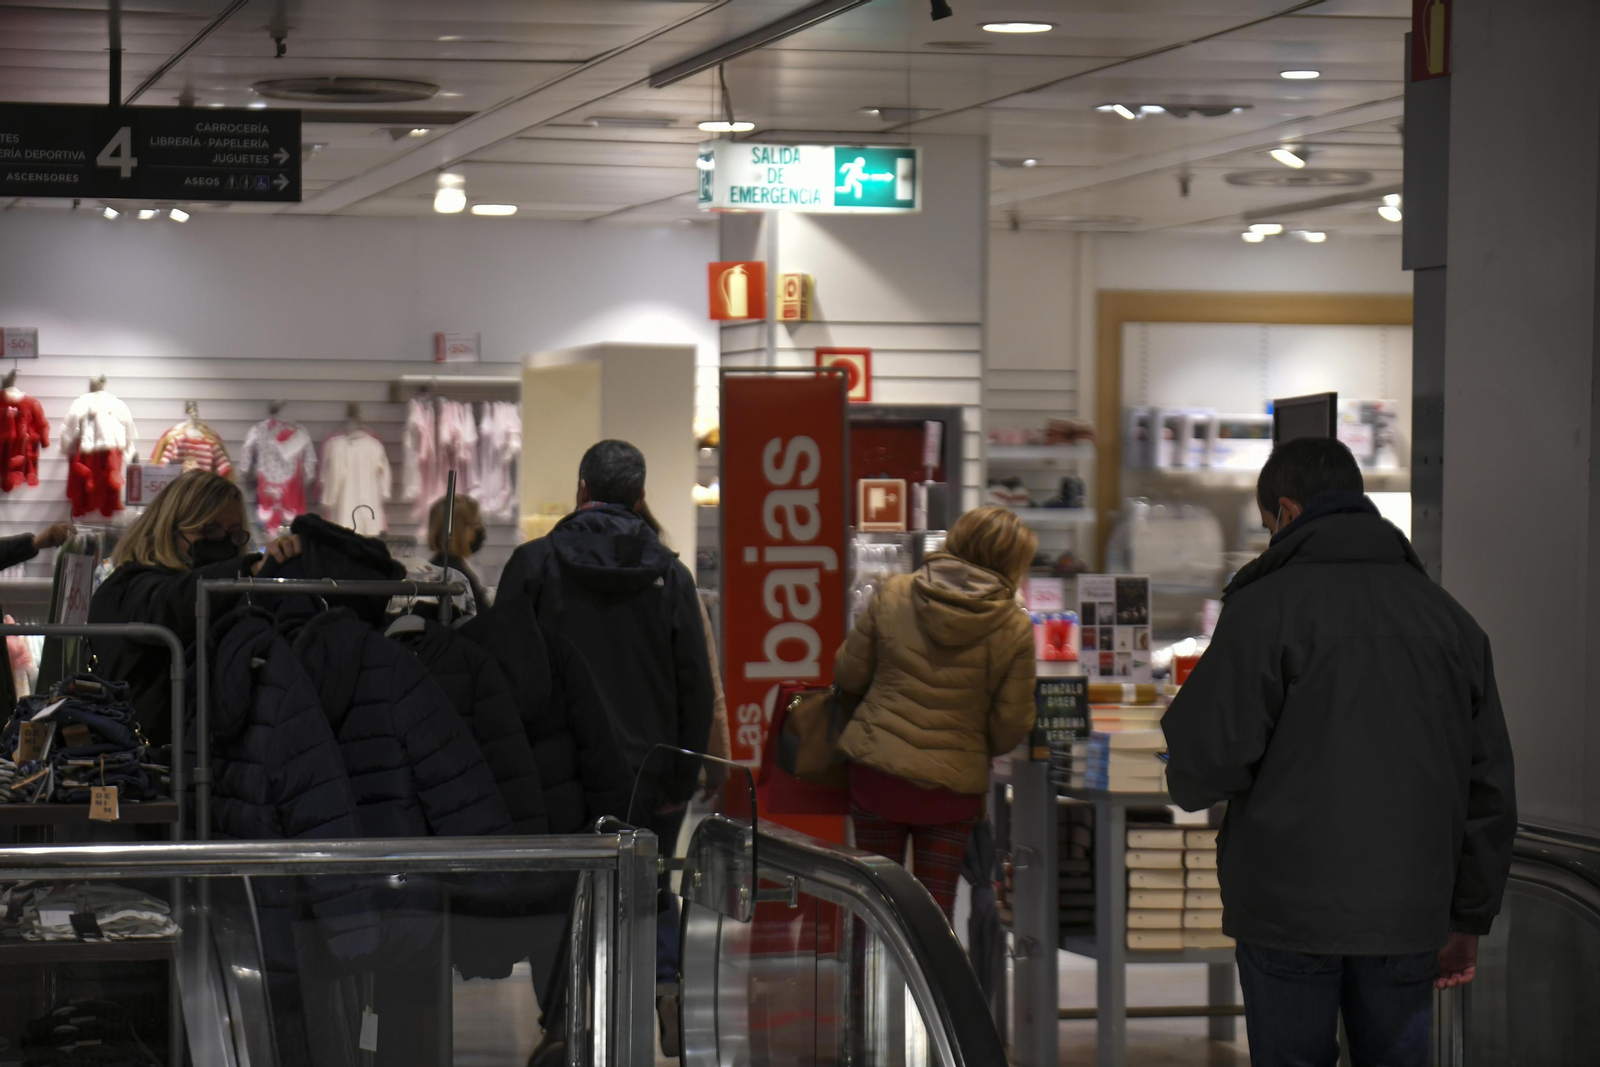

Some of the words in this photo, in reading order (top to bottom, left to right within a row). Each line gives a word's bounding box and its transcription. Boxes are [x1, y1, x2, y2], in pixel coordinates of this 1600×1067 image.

[195, 122, 270, 133] CARROCERÍA
[150, 135, 201, 147] LIBRERÍA
[208, 137, 270, 149] PAPELERÍA
[24, 149, 86, 160] DEPORTIVA
[96, 126, 138, 178] 4
[752, 147, 801, 164] SALIDA
[212, 153, 270, 164] JUGUETES
[6, 172, 79, 182] ASCENSORES
[184, 177, 220, 186] ASEOS
[767, 168, 785, 184] DE
[730, 186, 821, 204] EMERGENCIA
[1040, 683, 1084, 694] GONZALO
[737, 702, 762, 767] Las
